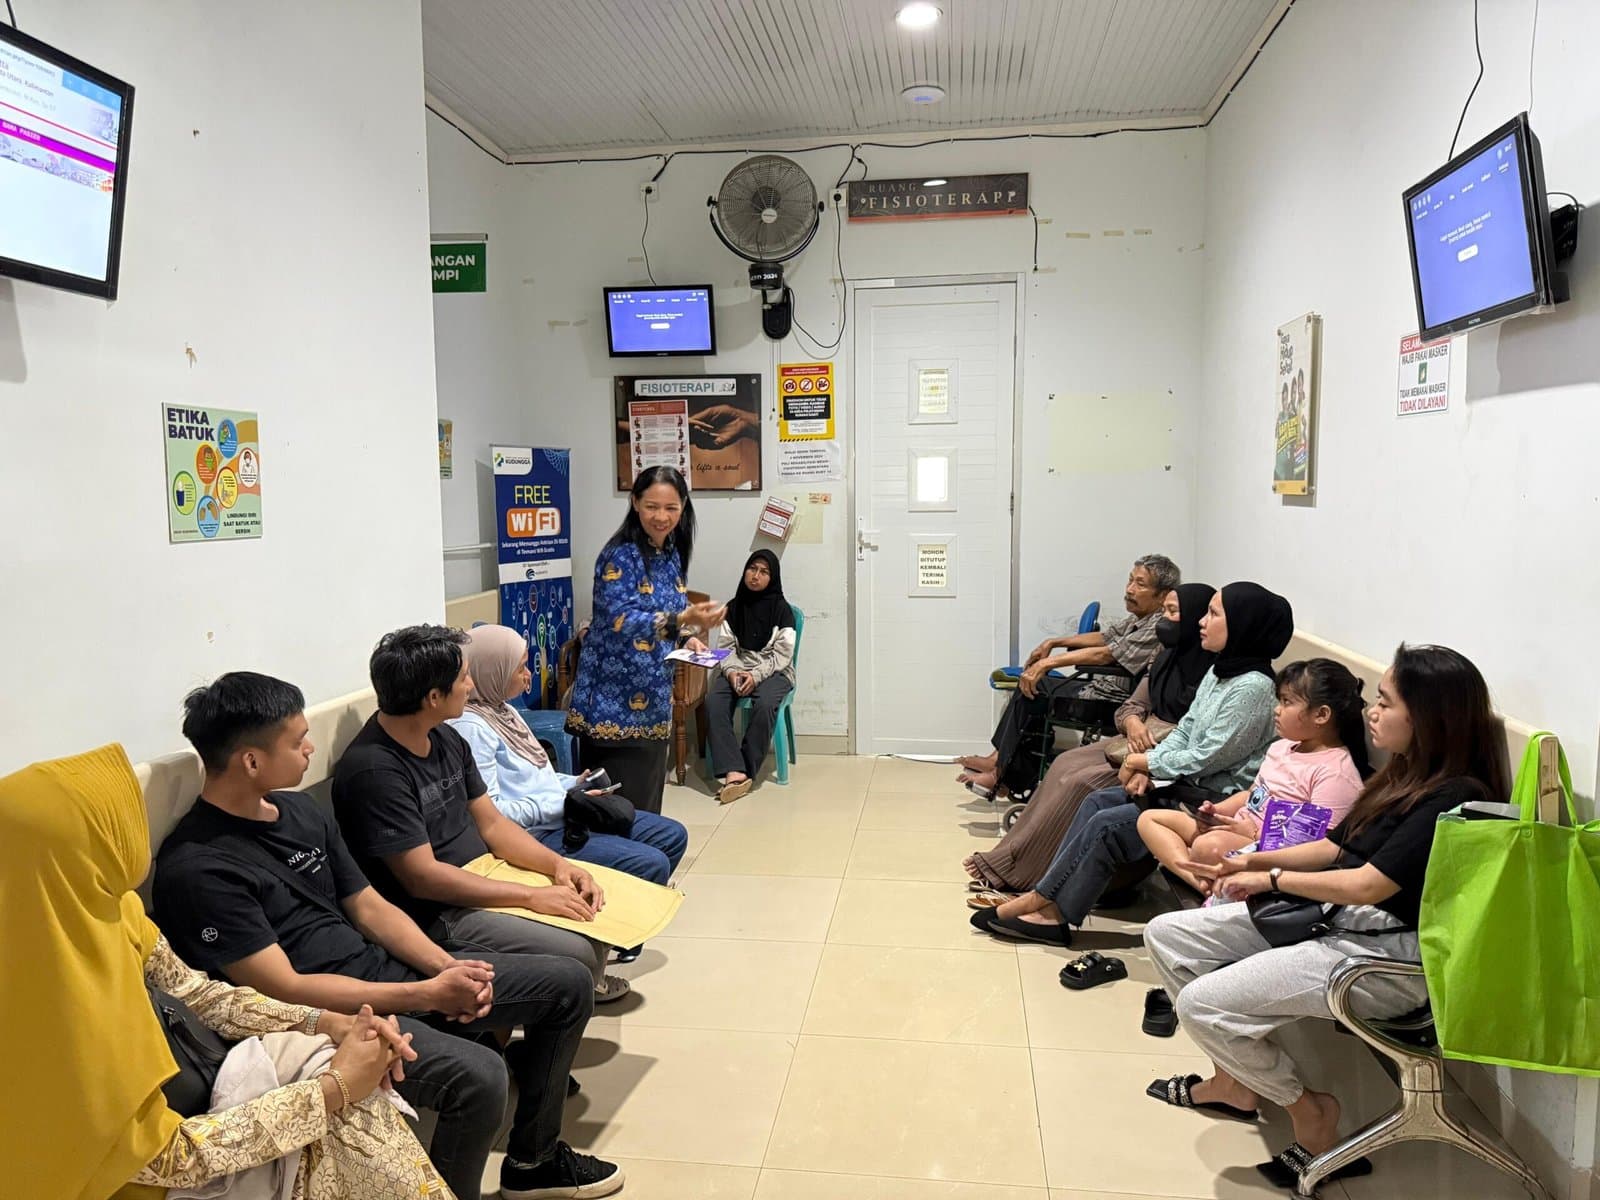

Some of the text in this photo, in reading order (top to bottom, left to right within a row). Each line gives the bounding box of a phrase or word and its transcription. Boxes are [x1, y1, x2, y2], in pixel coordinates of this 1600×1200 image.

[869, 183, 917, 193] RUANG
[1402, 345, 1448, 365] WAJIB PAKAI MASKER
[640, 382, 715, 394] FISIOTERAPI
[1429, 382, 1446, 394] MASKER
[1400, 395, 1446, 413] TIDAK DILAYANI
[167, 408, 210, 425] ETIKA
[168, 424, 215, 441] BATUK
[514, 485, 551, 504] FREE
